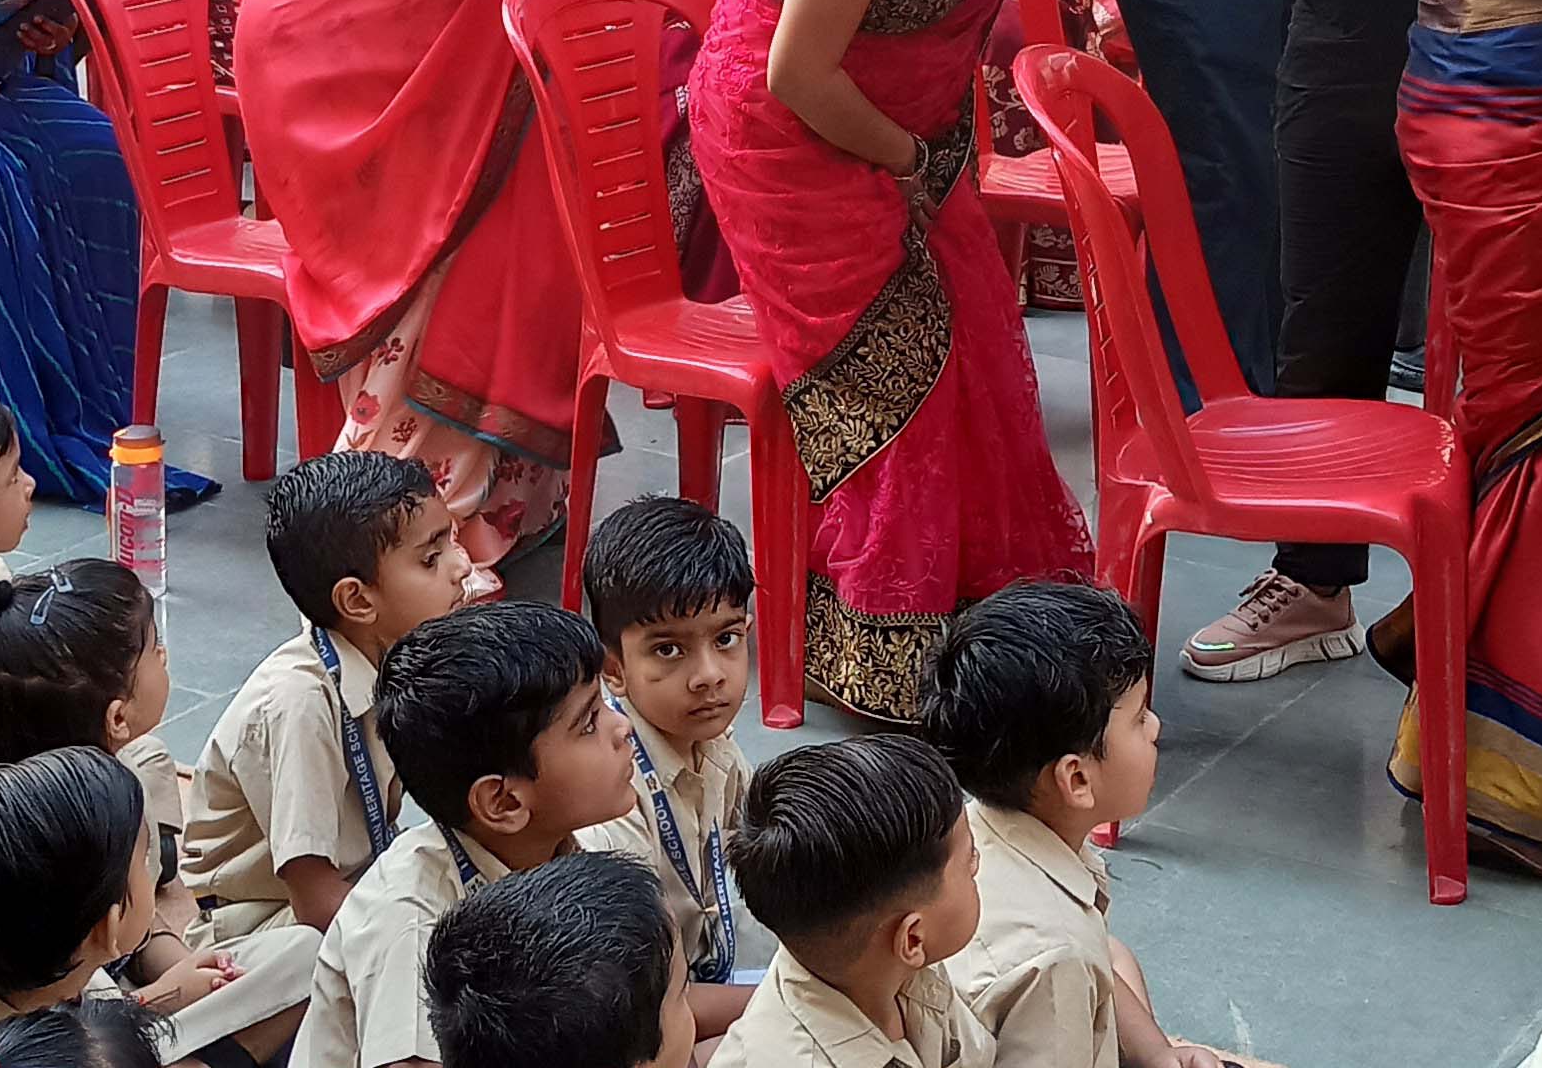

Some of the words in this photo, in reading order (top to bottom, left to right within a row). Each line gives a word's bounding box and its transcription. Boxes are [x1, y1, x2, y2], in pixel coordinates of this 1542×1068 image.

[352, 752, 385, 826] HERITAGE
[655, 799, 683, 860] SCHOOL
[710, 836, 731, 916] HERITAGE
